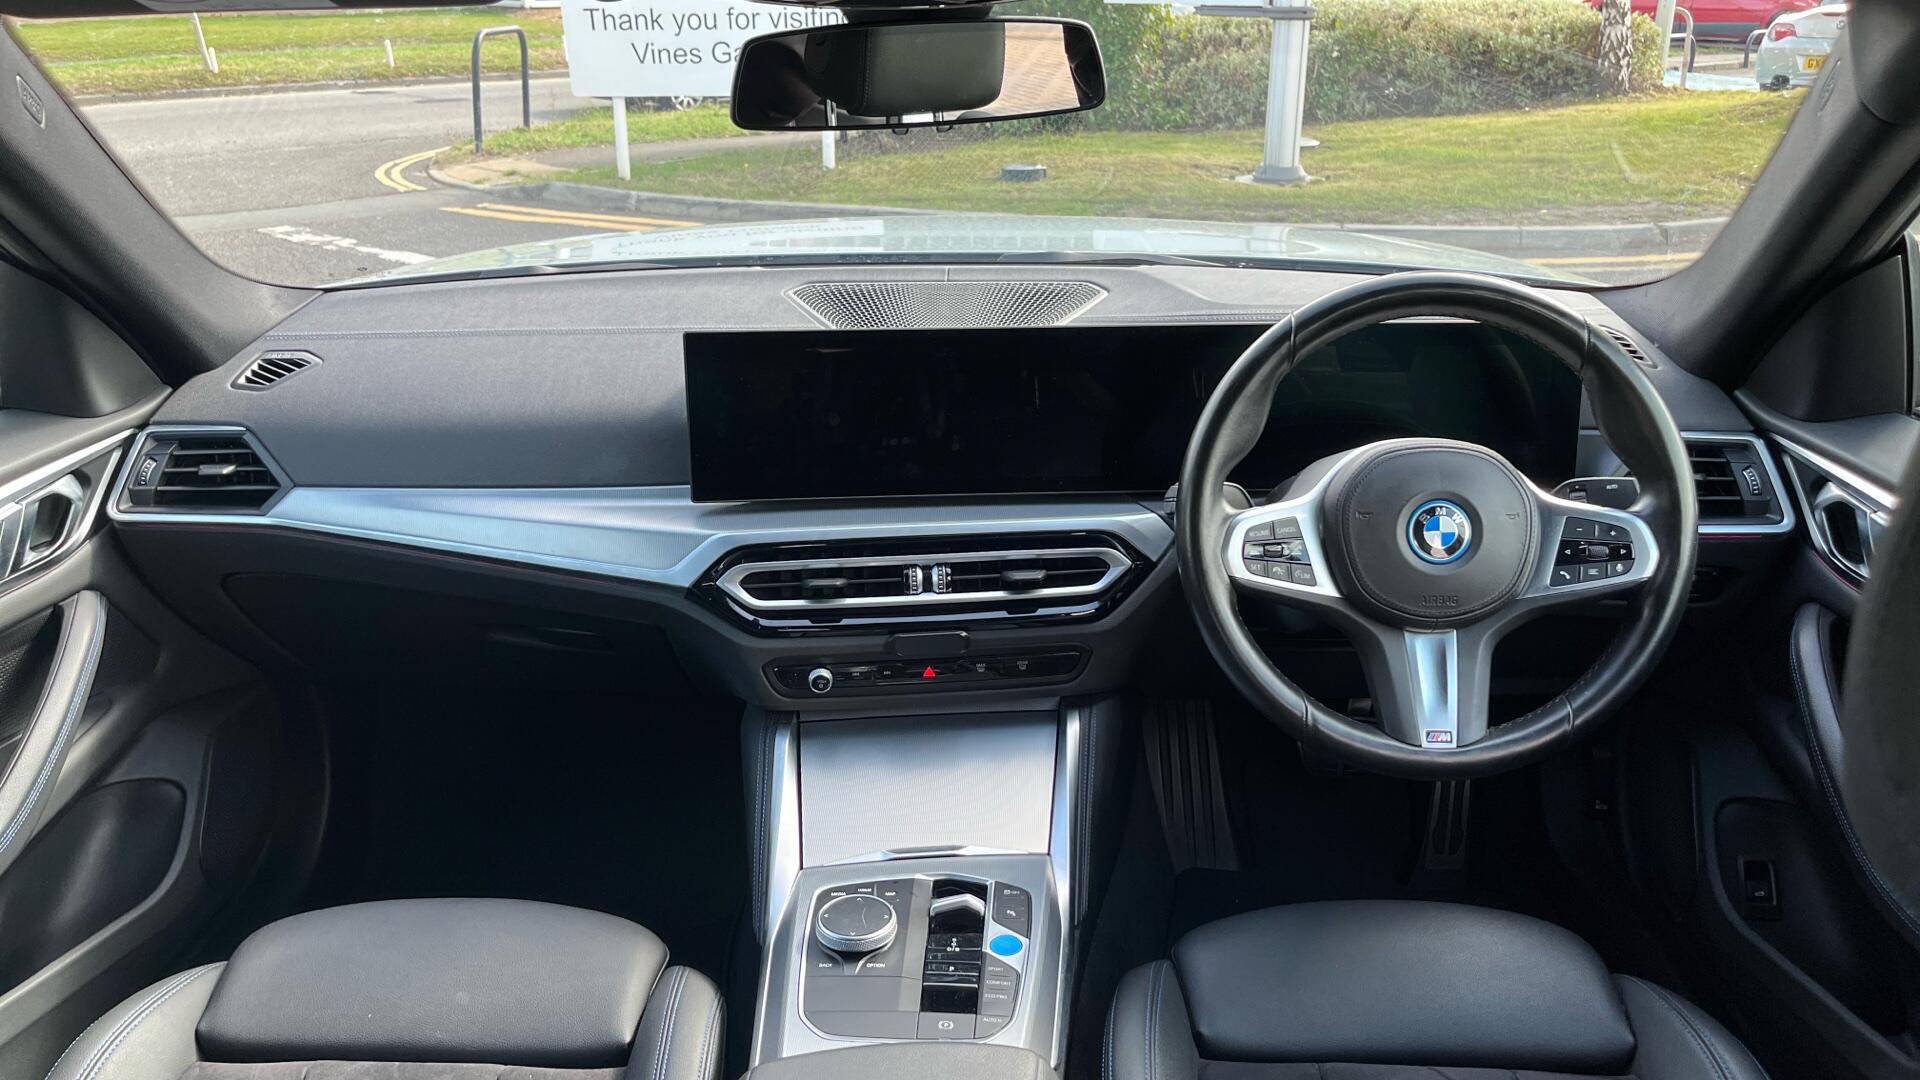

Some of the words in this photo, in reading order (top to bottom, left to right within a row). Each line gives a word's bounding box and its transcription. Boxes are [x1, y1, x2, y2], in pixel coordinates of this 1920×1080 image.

[583, 8, 664, 31] Thank
[672, 12, 718, 36] you
[726, 7, 760, 30] for
[630, 42, 702, 64] Vines
[1418, 507, 1463, 524] BMW
[1419, 595, 1458, 606] AIRBAG
